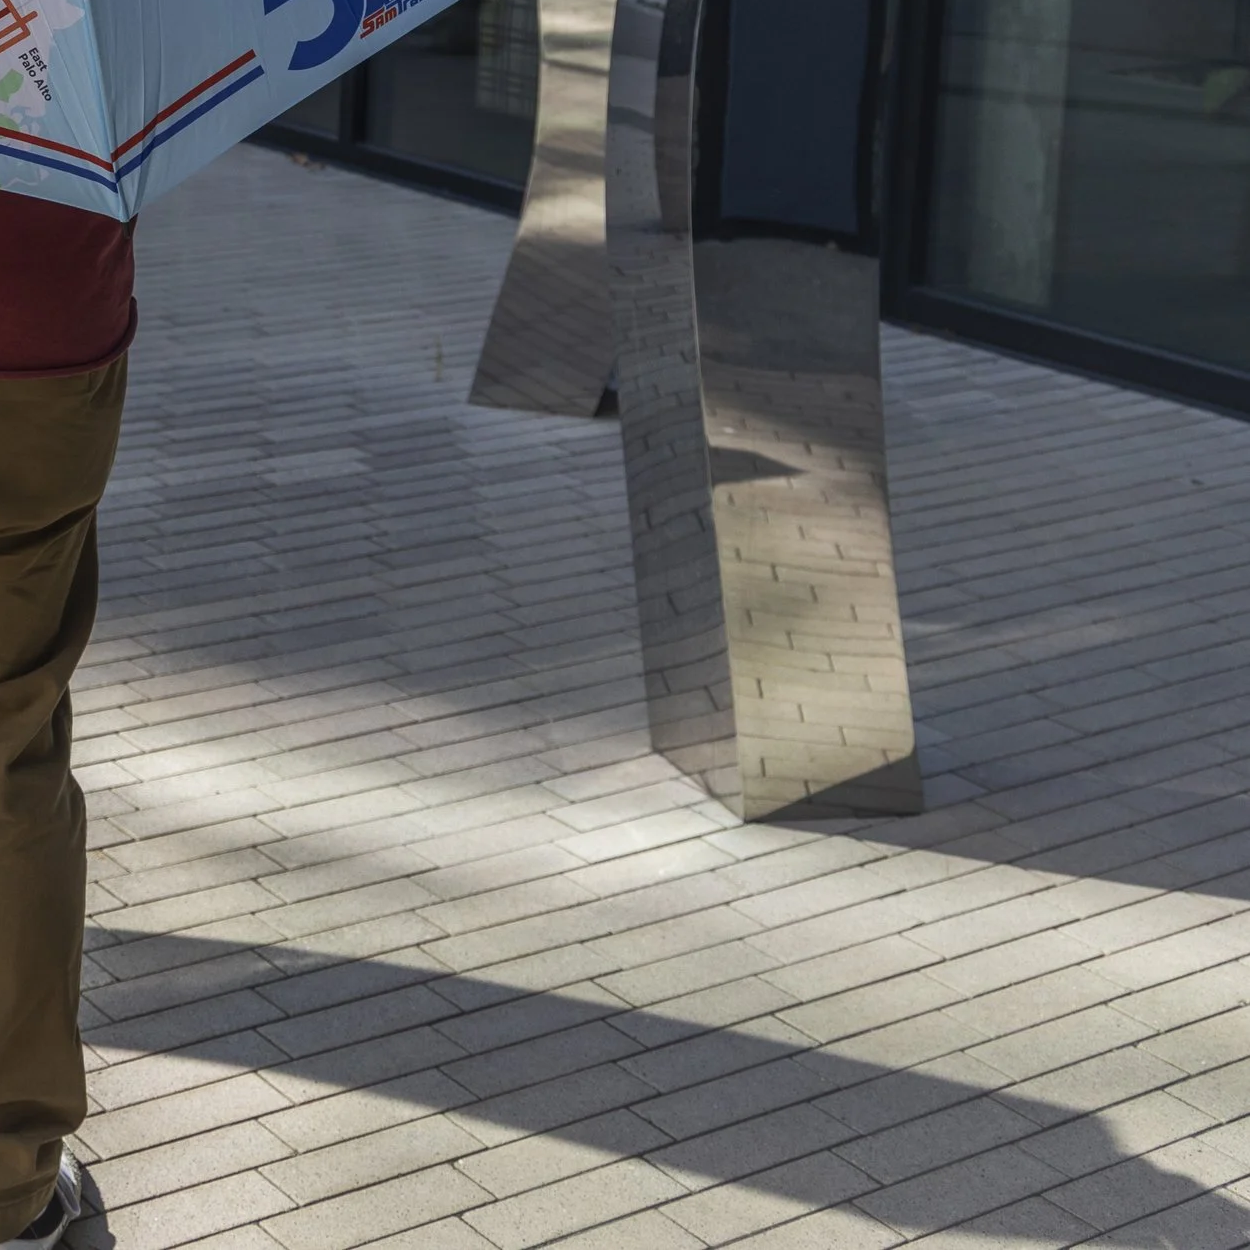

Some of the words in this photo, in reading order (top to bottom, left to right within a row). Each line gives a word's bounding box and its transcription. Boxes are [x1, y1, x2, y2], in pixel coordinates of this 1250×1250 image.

[18, 53, 36, 78] Palo
[34, 76, 52, 101] Alto
[28, 47, 47, 72] East
